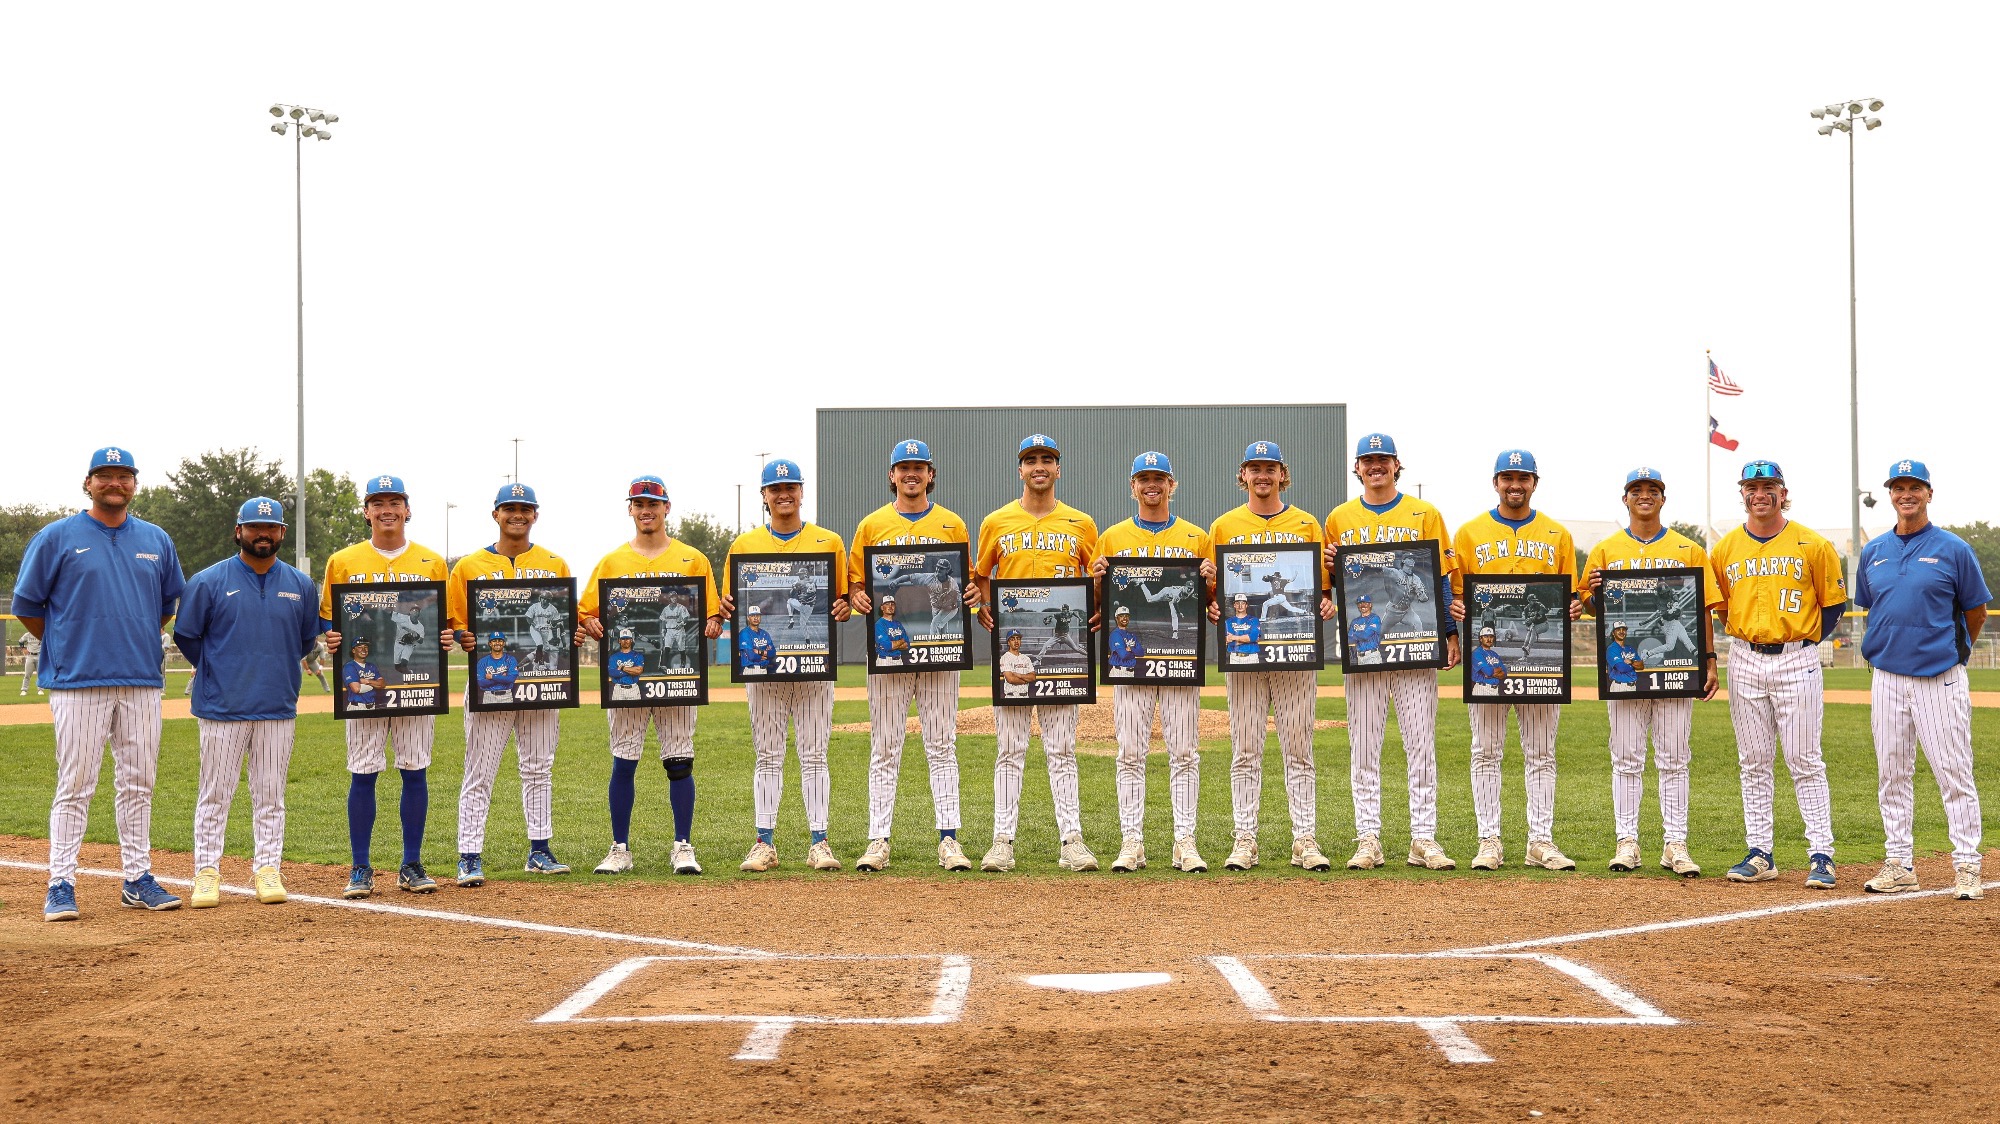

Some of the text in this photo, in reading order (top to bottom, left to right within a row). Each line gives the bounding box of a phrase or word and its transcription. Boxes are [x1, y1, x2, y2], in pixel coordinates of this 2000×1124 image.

[999, 532, 1077, 558] ST. MARY'S
[1475, 539, 1555, 568] ST. MARY'S
[1726, 556, 1803, 589] ST. MARY'S
[1778, 588, 1802, 613] 15
[930, 646, 963, 655] BRANDON
[1288, 645, 1314, 653] DANIEL
[1409, 643, 1434, 652] BRODY
[908, 648, 928, 663] 32
[930, 654, 960, 663] VASQUEZ
[1265, 646, 1286, 662] 31
[1288, 653, 1308, 662] VOGT
[1384, 645, 1406, 663] 27
[776, 656, 797, 673] 20
[801, 656, 824, 664] KALEB
[801, 665, 826, 673] GAUNA
[1146, 660, 1166, 678] 26
[1169, 661, 1192, 669] CHASE
[403, 673, 429, 681] INFIELD
[1169, 670, 1196, 678] BRIGHT
[1664, 672, 1689, 681] JACOB
[667, 681, 695, 689] TRISTAN
[1650, 672, 1660, 690] 1
[1664, 681, 1684, 689] KING
[541, 683, 562, 692] MATT
[645, 682, 666, 698] 30
[1035, 681, 1054, 696] 22
[1504, 678, 1524, 695] 33
[1526, 686, 1562, 694] MENDOZA
[401, 689, 434, 699] RAITHEN
[515, 684, 537, 701] 40
[541, 692, 567, 700] GAUNA
[668, 689, 697, 697] MORENO
[1056, 688, 1087, 696] BURGESS
[386, 690, 397, 708] 2
[401, 698, 434, 708] MALONE
